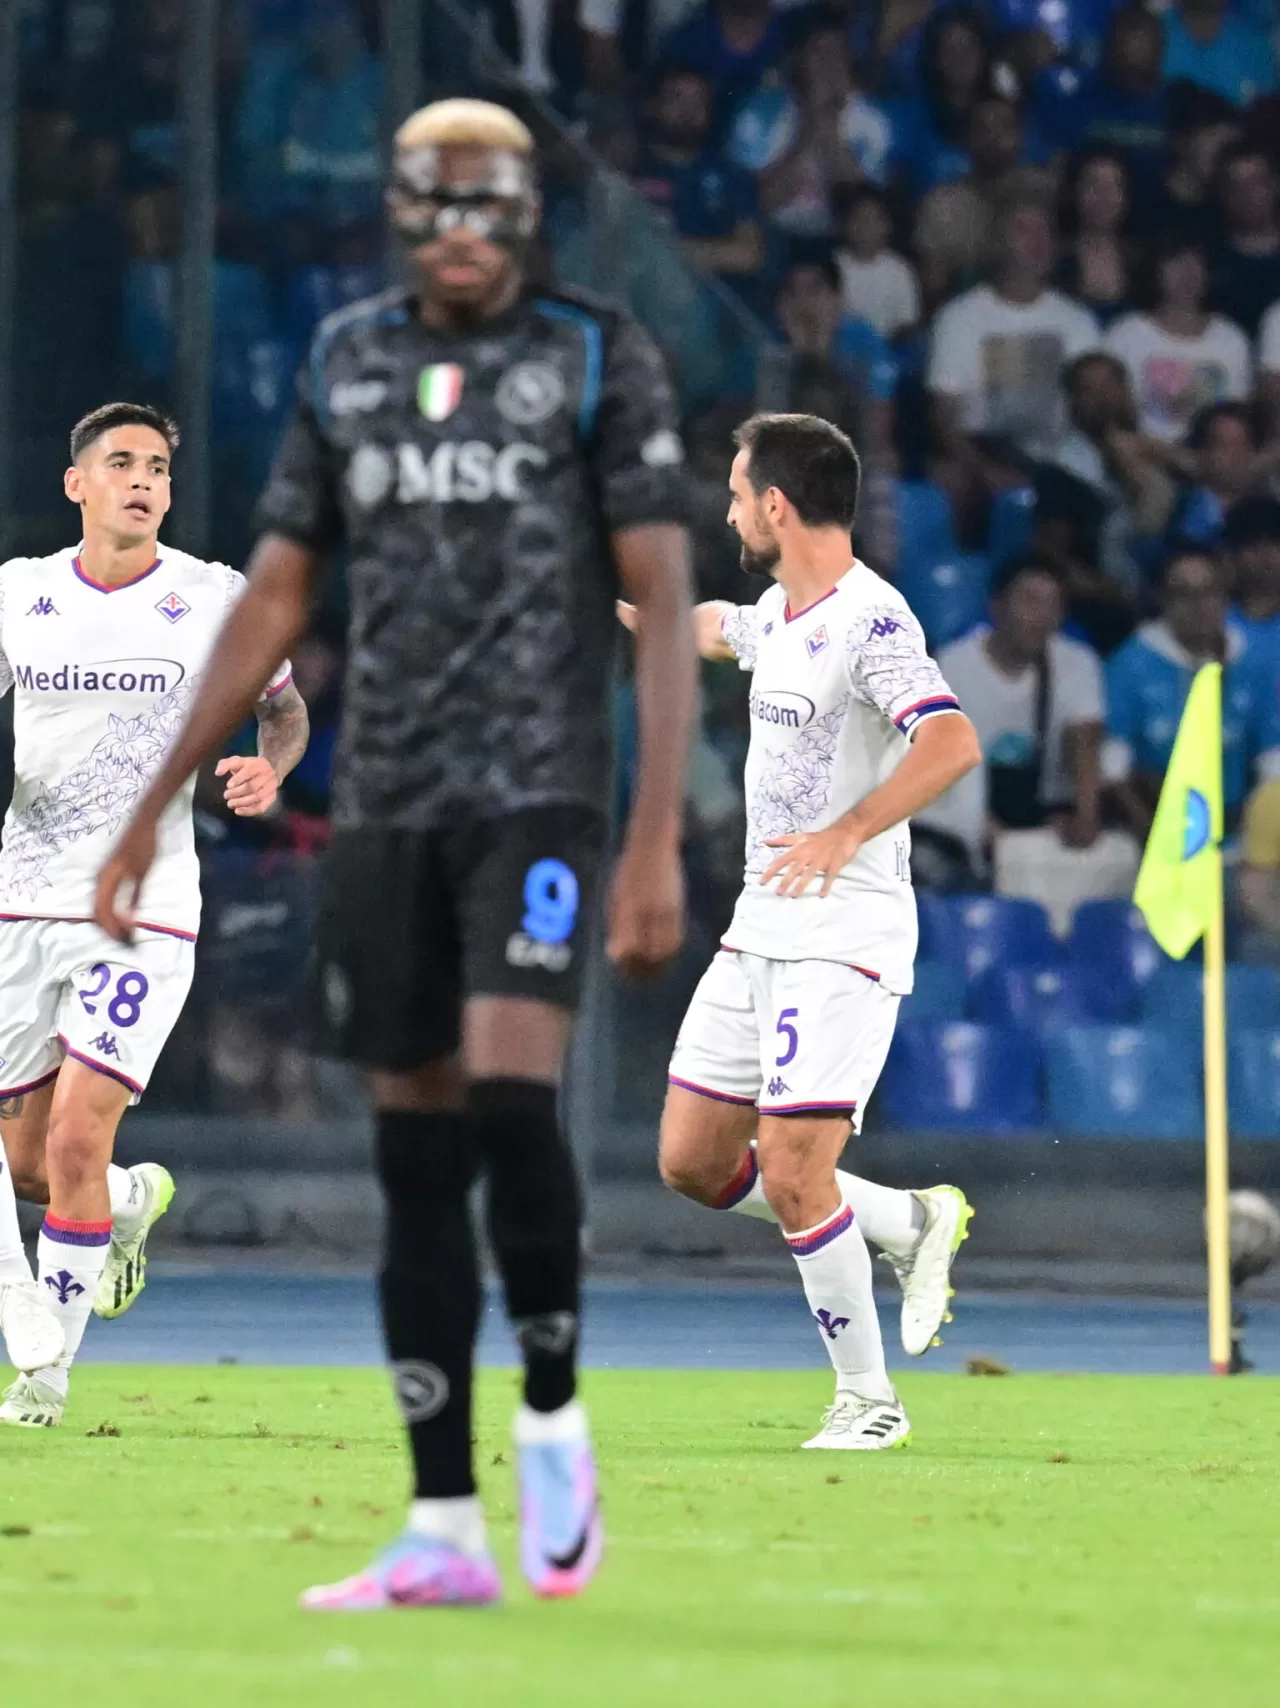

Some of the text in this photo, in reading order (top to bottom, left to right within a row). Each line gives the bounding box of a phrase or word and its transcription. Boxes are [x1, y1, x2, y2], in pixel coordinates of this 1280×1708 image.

[397, 439, 548, 503] MSC
[16, 664, 167, 693] Mediacom
[522, 857, 580, 944] 9
[79, 963, 149, 1028] 28
[775, 1007, 799, 1067] 5
